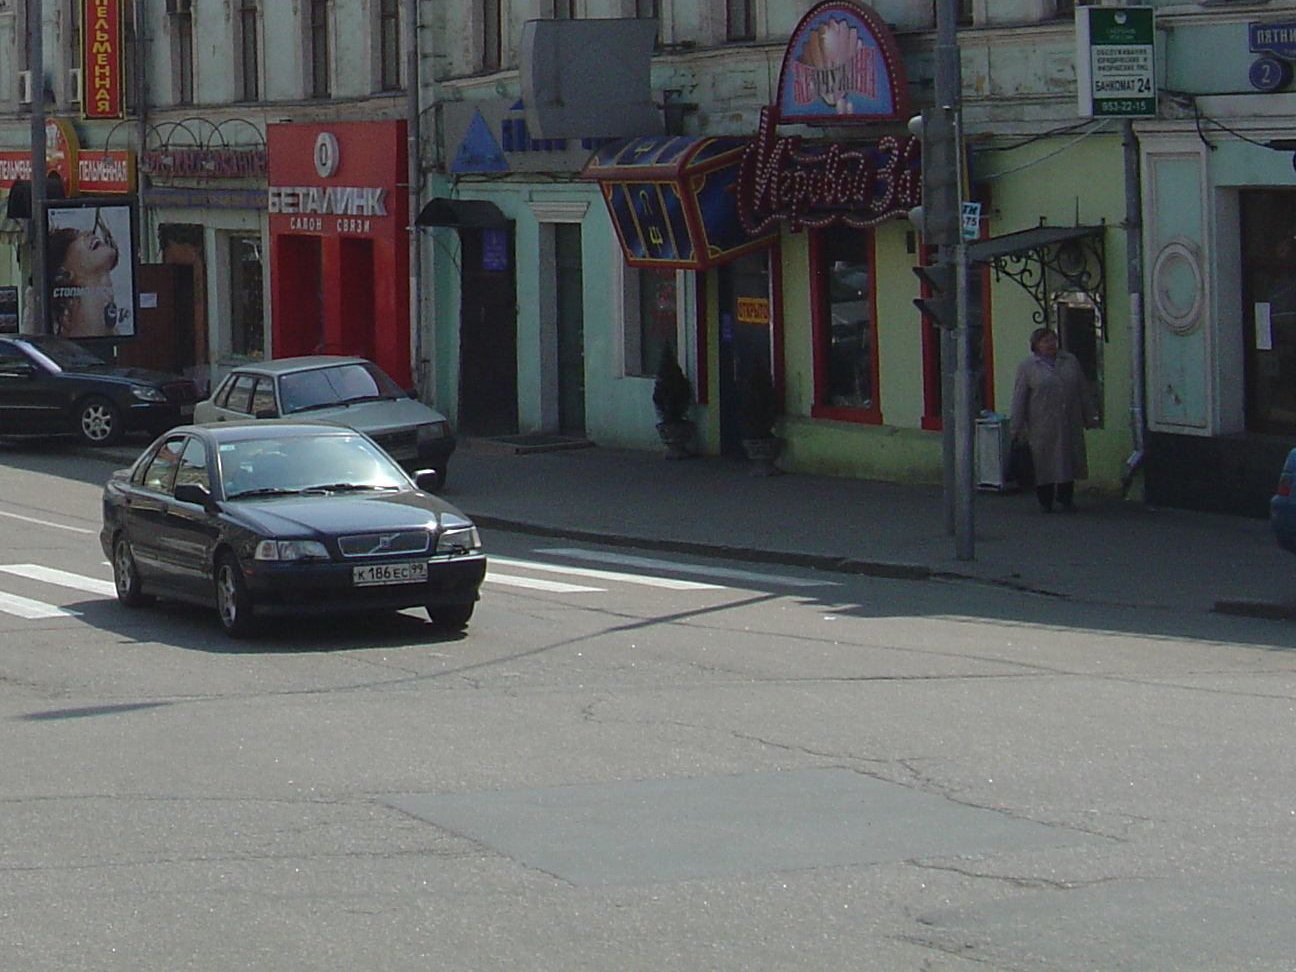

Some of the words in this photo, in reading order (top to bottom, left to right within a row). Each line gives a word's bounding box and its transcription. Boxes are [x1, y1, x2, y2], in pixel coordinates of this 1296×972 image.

[1261, 64, 1271, 83] 2
[1095, 80, 1135, 92] БАНКОМАТ
[1137, 78, 1151, 93] 24
[78, 160, 127, 182] ПЕЛЬМЕННАЯ
[268, 186, 388, 216] БЕТАЛИНК
[290, 217, 322, 230] САЛОН
[336, 218, 370, 233] СВЯЗИ
